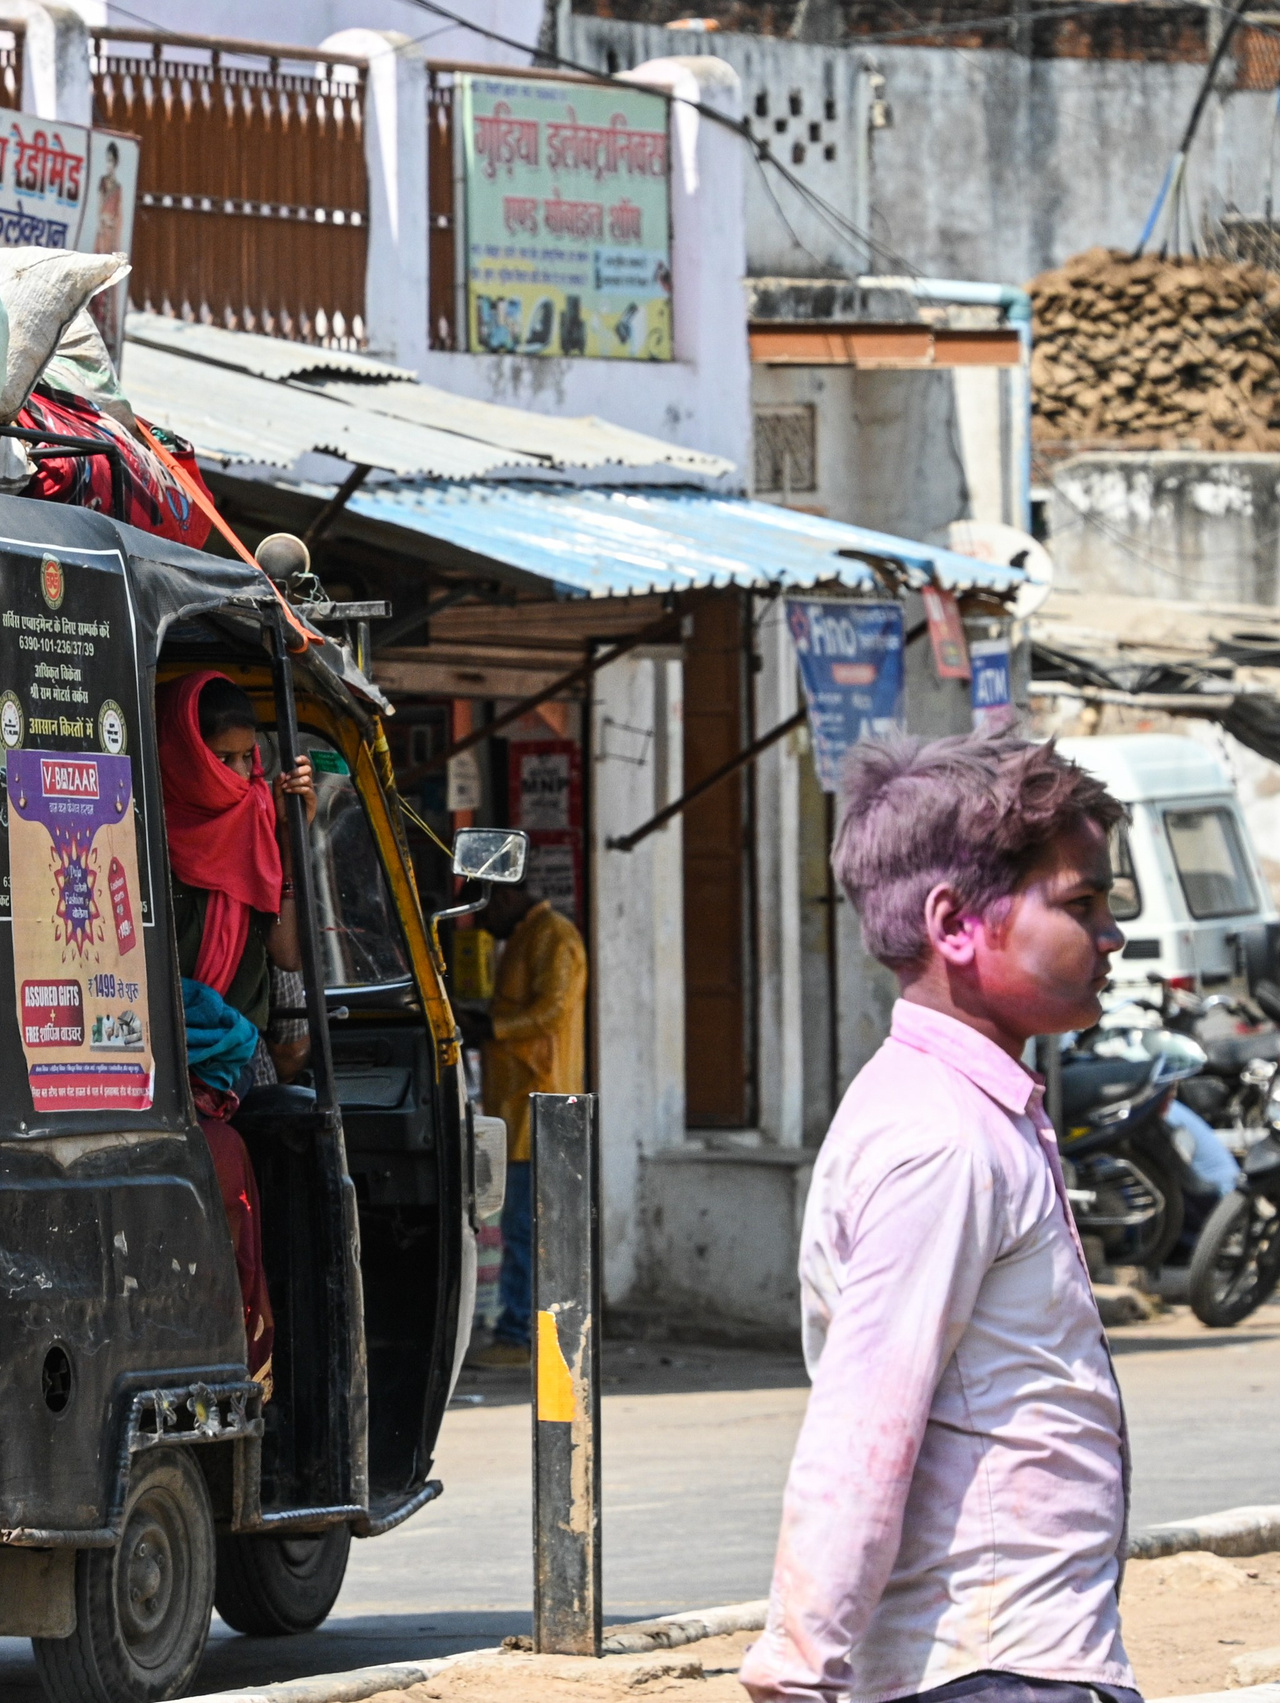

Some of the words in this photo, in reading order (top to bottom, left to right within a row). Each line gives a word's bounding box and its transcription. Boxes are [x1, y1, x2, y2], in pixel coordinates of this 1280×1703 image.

[976, 667, 1008, 702] ATM
[29, 718, 58, 736] आसान
[86, 717, 94, 739] में
[42, 766, 97, 792] V-BAZAAR
[24, 986, 58, 1007] ASSURED
[58, 985, 80, 1007] GIFTS
[25, 1026, 40, 1043] FREE
